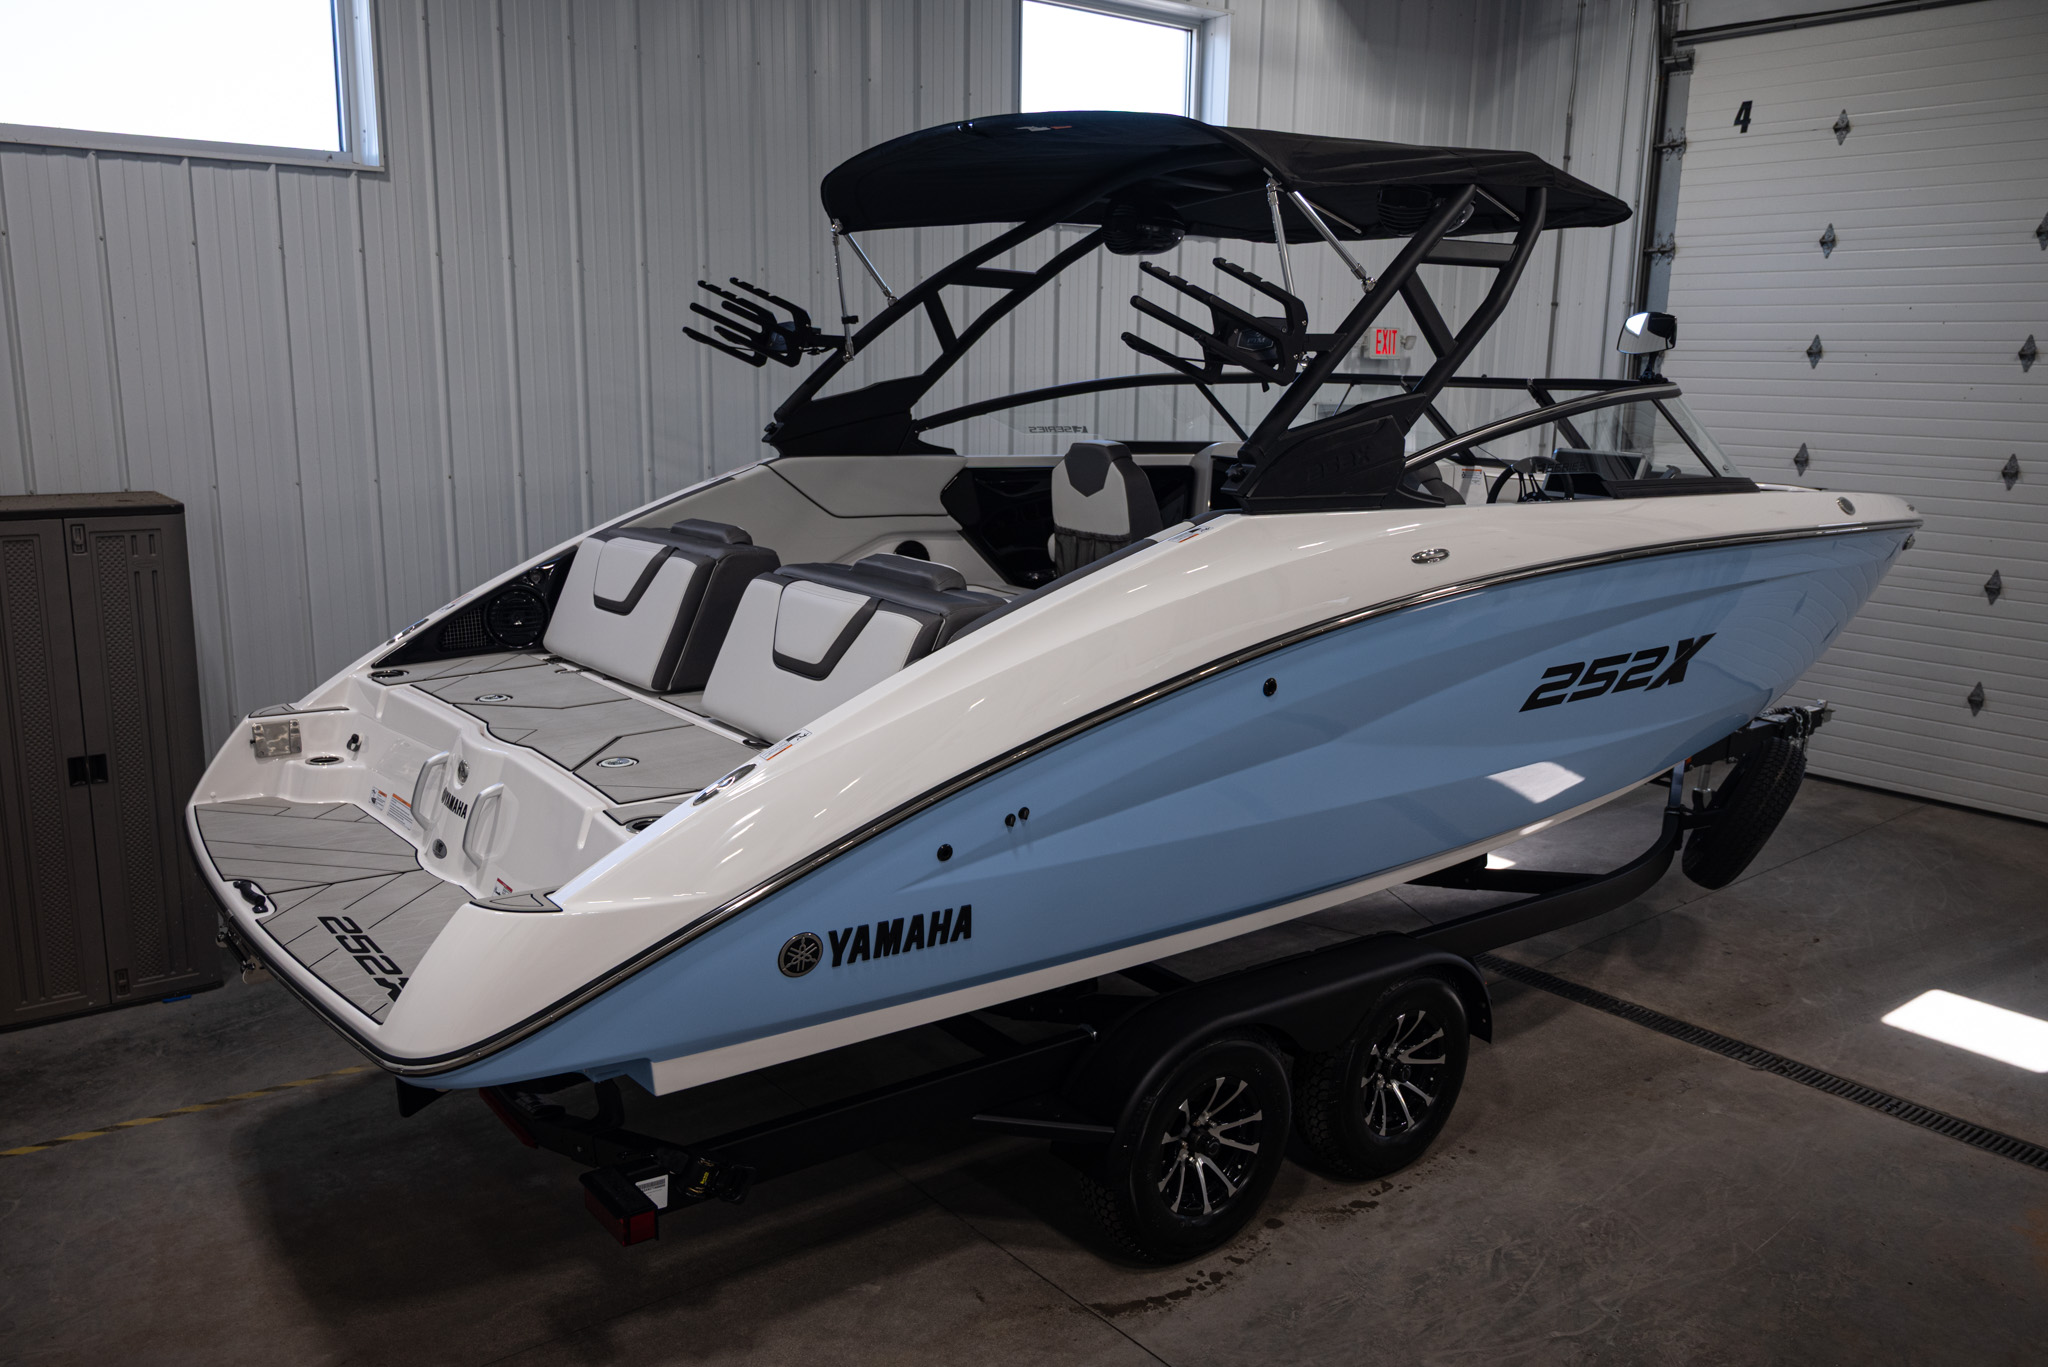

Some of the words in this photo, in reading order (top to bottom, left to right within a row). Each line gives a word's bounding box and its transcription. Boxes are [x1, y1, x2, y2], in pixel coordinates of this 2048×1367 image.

[1733, 100, 1753, 133] 4
[1375, 329, 1398, 355] EXIT
[1518, 632, 1717, 713] 252X
[443, 788, 468, 819] YAMAHA
[828, 904, 972, 967] YAMAHA
